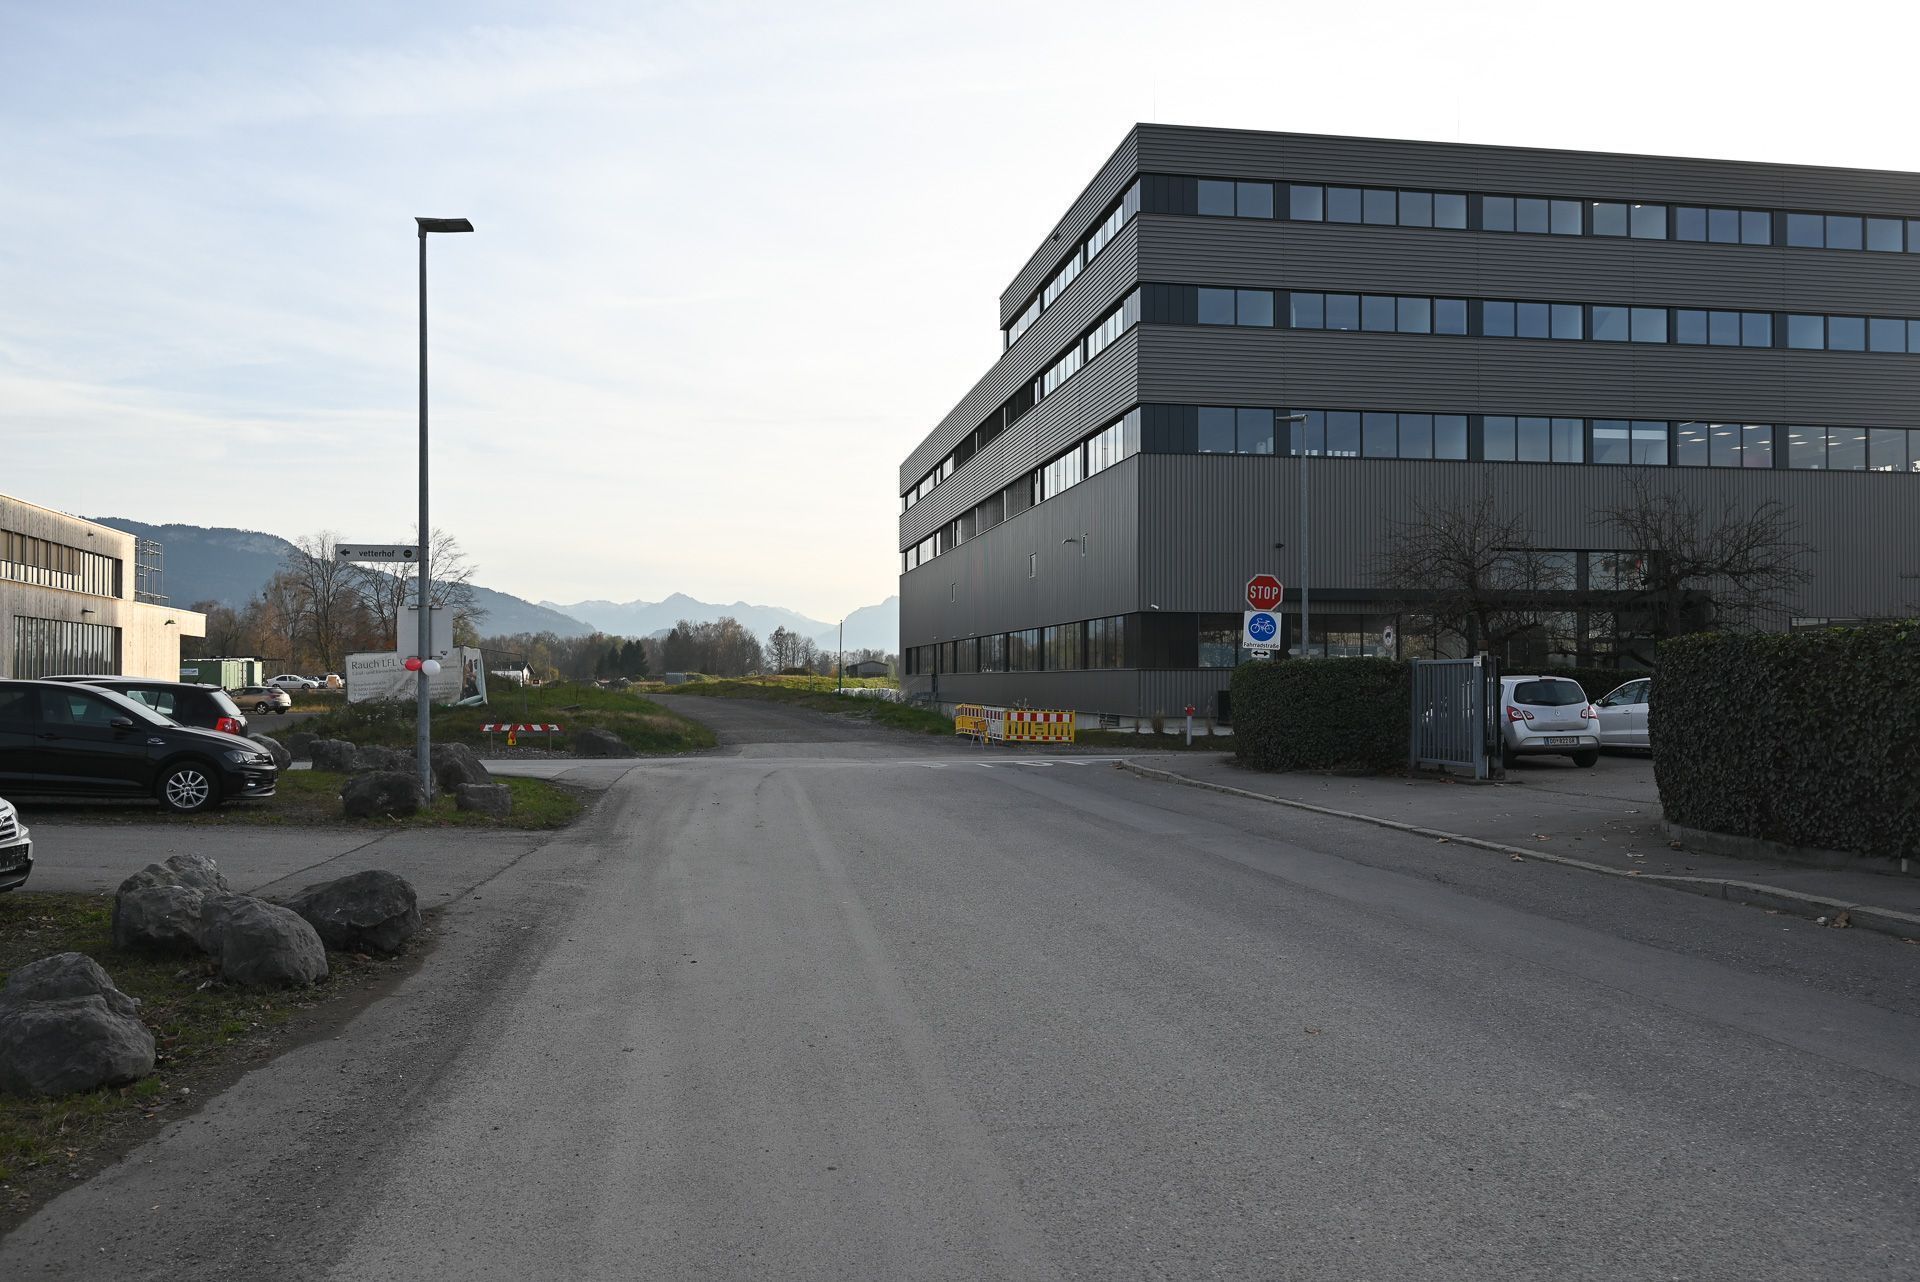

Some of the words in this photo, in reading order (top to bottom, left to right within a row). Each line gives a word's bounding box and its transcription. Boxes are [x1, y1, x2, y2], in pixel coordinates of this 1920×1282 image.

[358, 549, 396, 557] vetterhof
[1250, 585, 1279, 600] STOP
[1243, 641, 1280, 649] Fahrradstraße
[351, 659, 380, 670] Rauch
[382, 658, 397, 668] LFL
